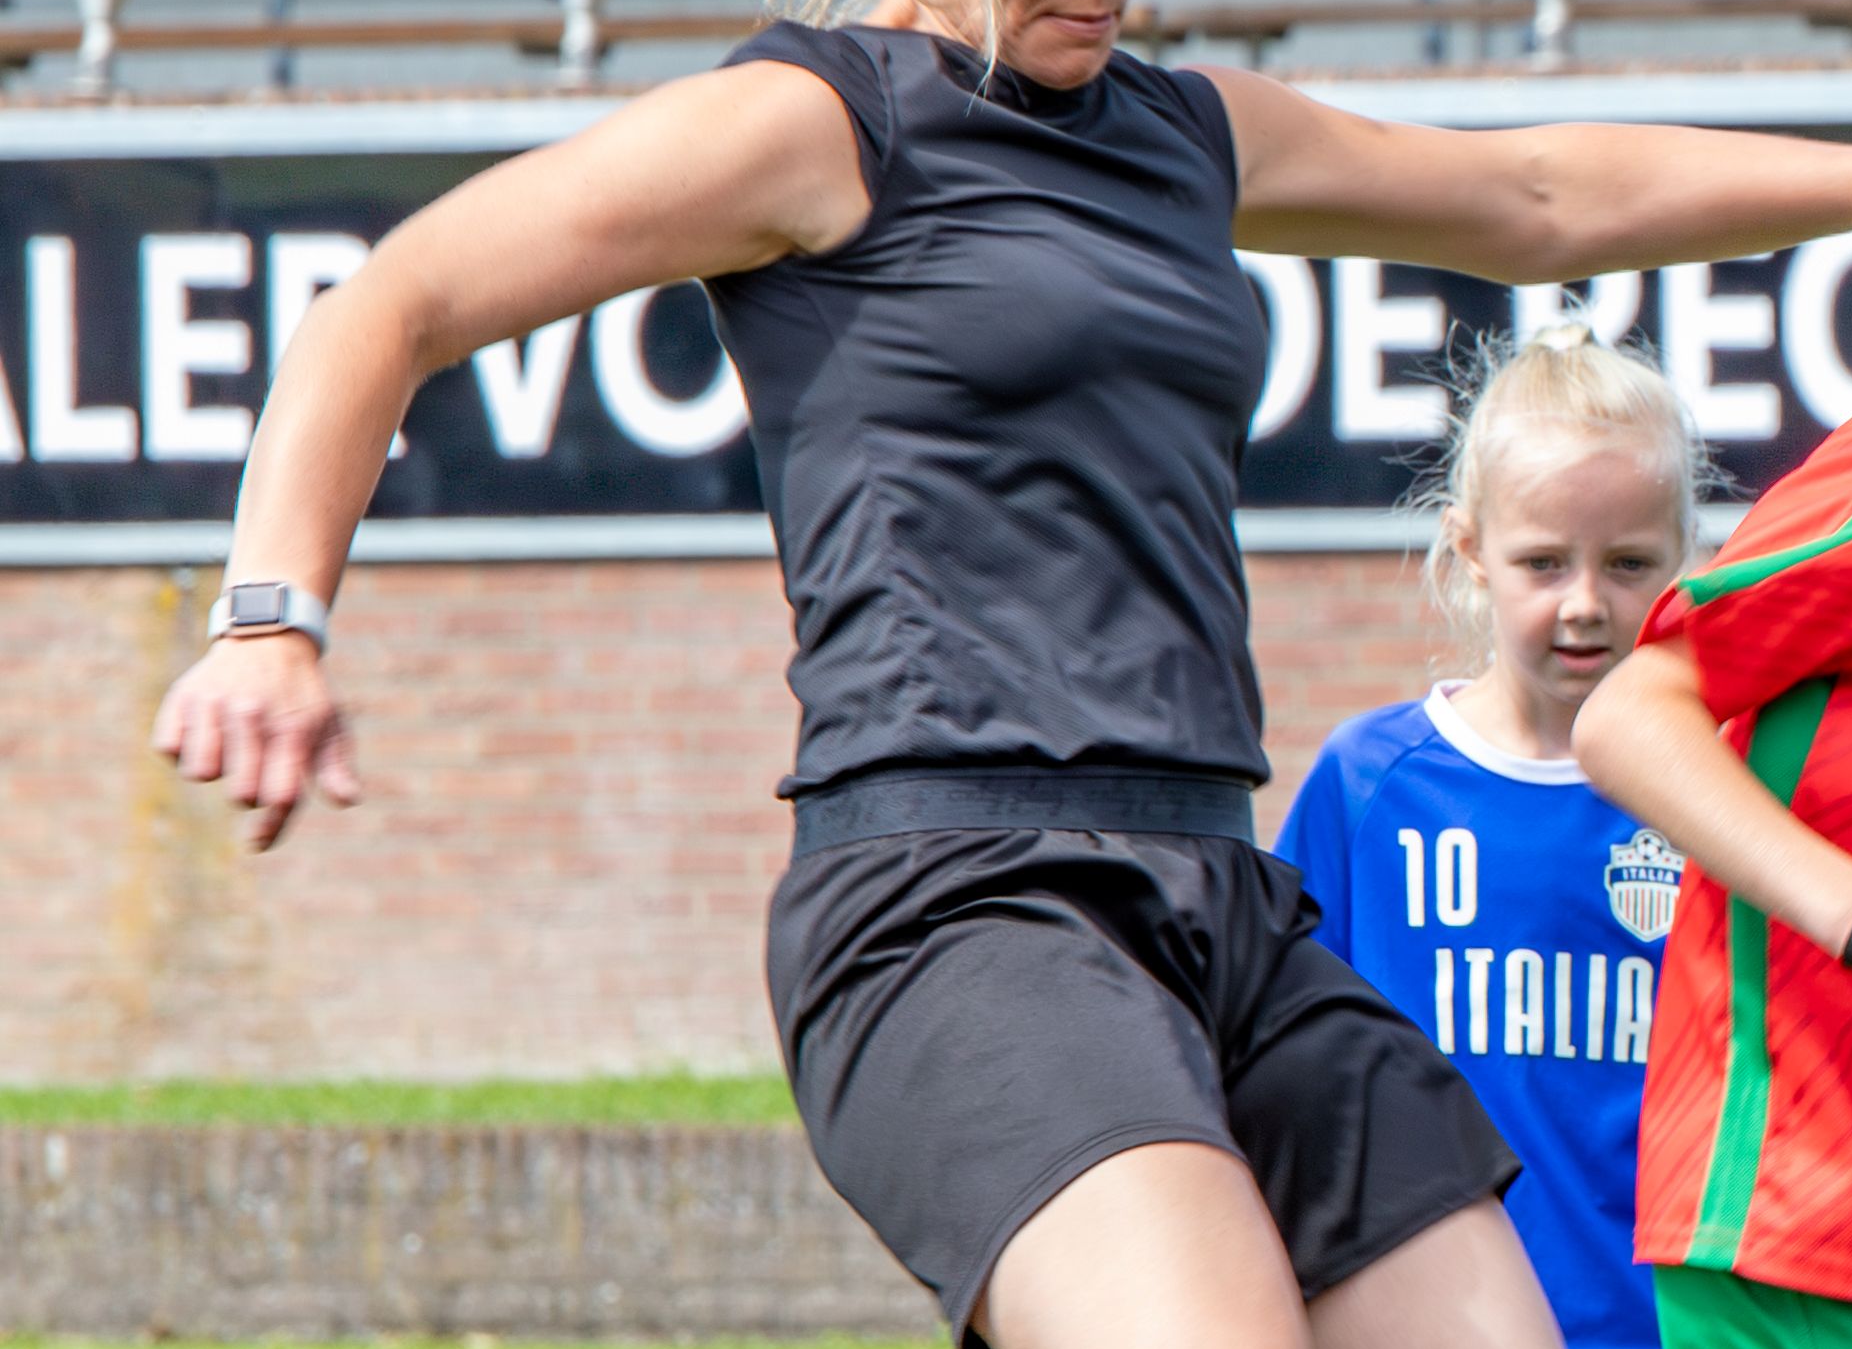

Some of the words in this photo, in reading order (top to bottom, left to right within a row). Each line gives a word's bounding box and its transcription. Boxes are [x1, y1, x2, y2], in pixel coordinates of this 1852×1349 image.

[0, 232, 409, 464] LE
[1397, 827, 1477, 928] 10
[1622, 867, 1675, 884] ITALIA
[1434, 947, 1653, 1062] ITALIA
